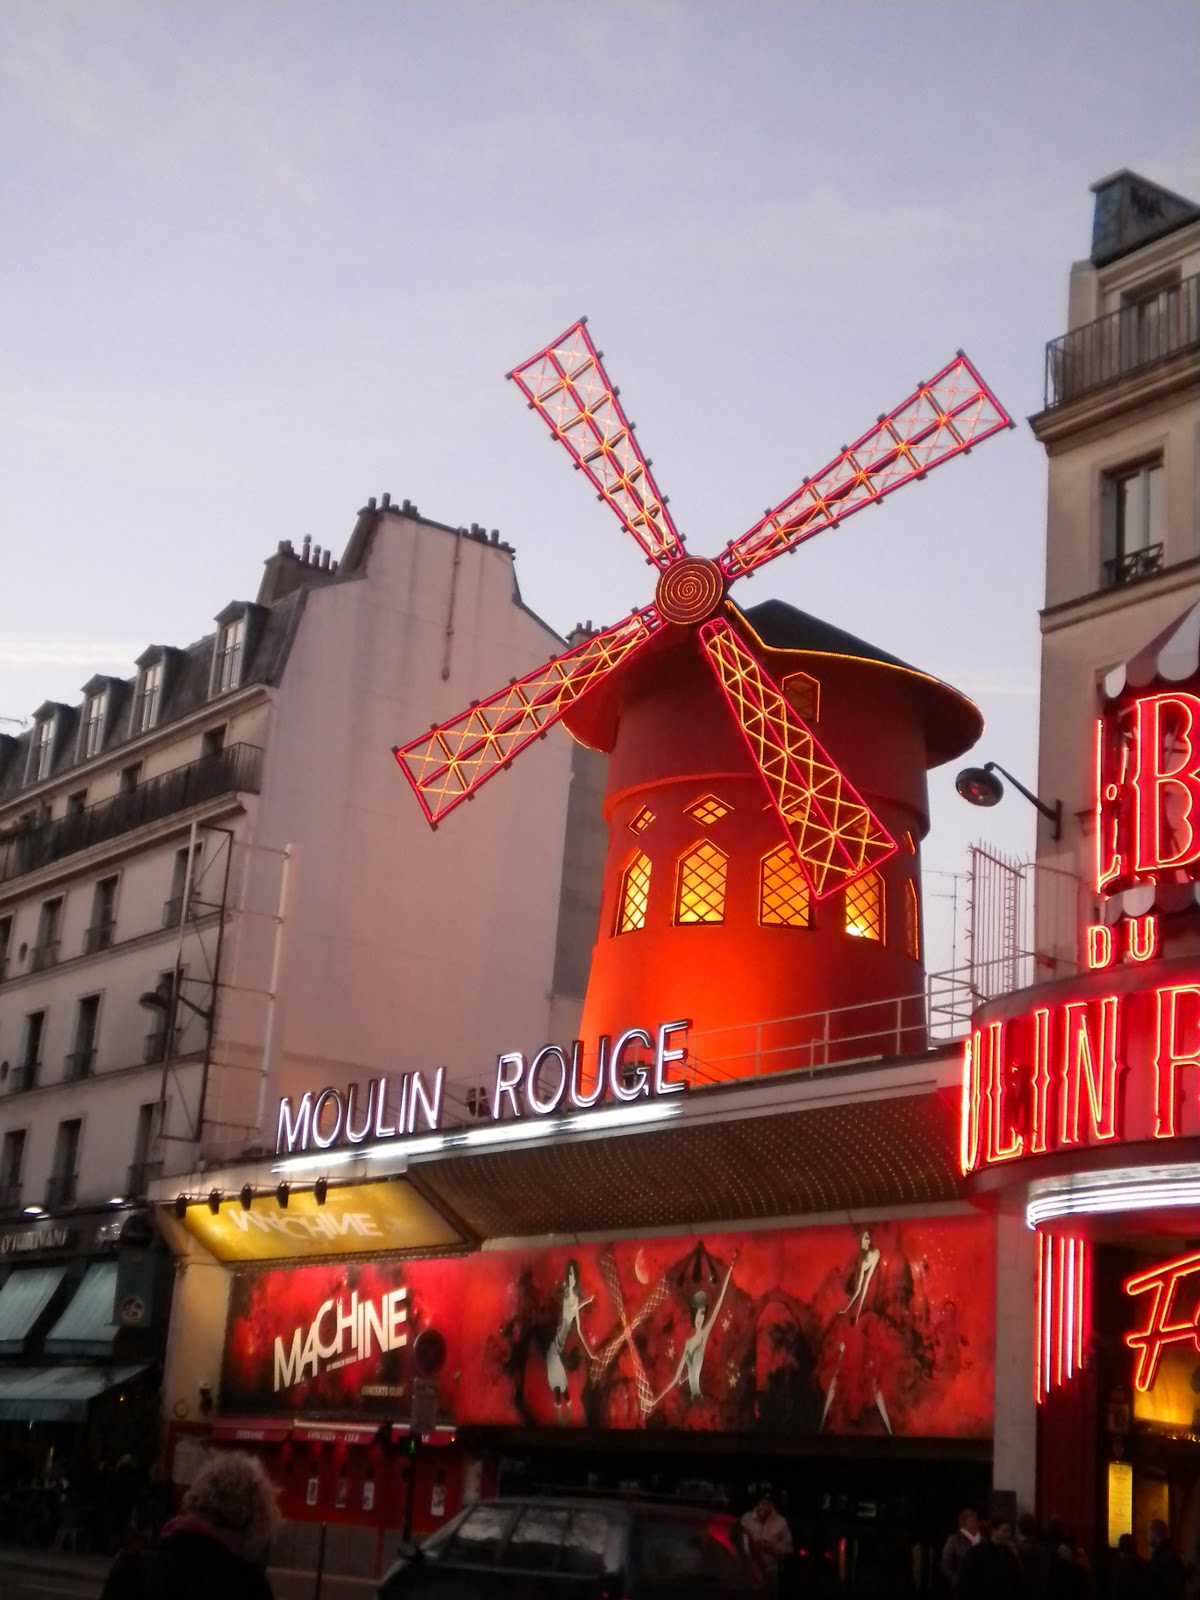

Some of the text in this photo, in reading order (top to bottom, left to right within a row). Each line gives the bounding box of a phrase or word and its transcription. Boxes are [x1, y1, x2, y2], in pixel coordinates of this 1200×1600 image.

[1087, 914, 1160, 970] DU
[275, 1018, 693, 1155] MOULIN ROUGE
[273, 1287, 407, 1393] MACHINE
